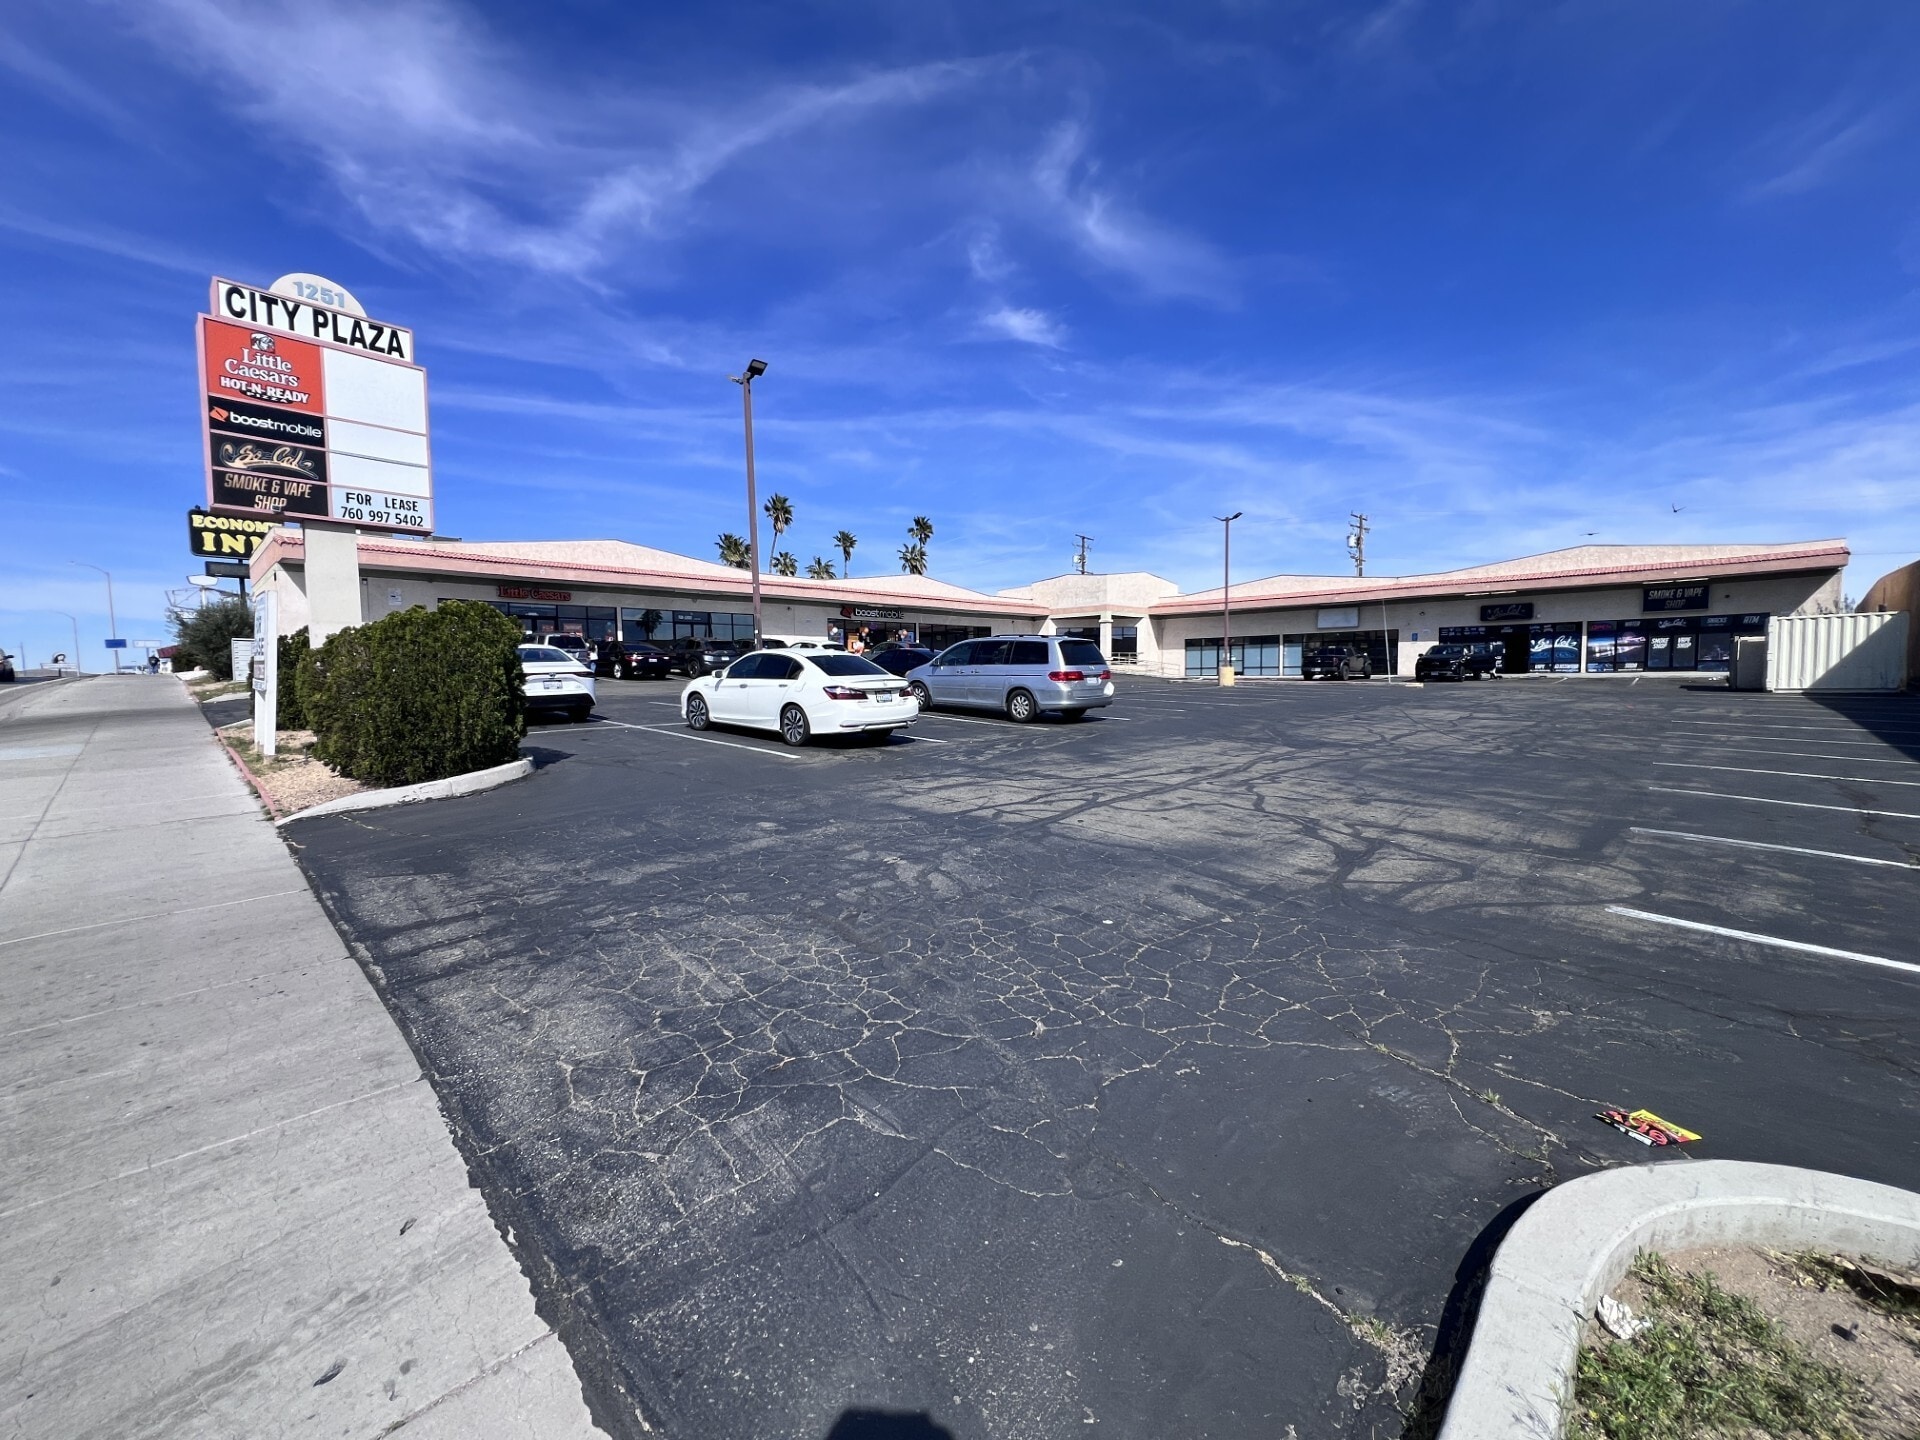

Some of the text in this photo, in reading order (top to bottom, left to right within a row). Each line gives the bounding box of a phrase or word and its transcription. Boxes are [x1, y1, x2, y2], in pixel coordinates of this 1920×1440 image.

[293, 281, 345, 308] 1251
[226, 286, 405, 358] CITY PLAZA
[241, 347, 292, 373] Little
[224, 358, 299, 387] Caesars
[224, 473, 312, 498] SMOKE & VAPE
[254, 494, 288, 511] SHOP
[345, 492, 419, 512] FOR LEASE
[341, 506, 424, 527] 760 997 5402
[499, 585, 572, 601] Little Caesars
[1648, 587, 1704, 600] SMOKE & VAPE
[1664, 599, 1686, 609] SHOP
[1743, 616, 1760, 624] ATM
